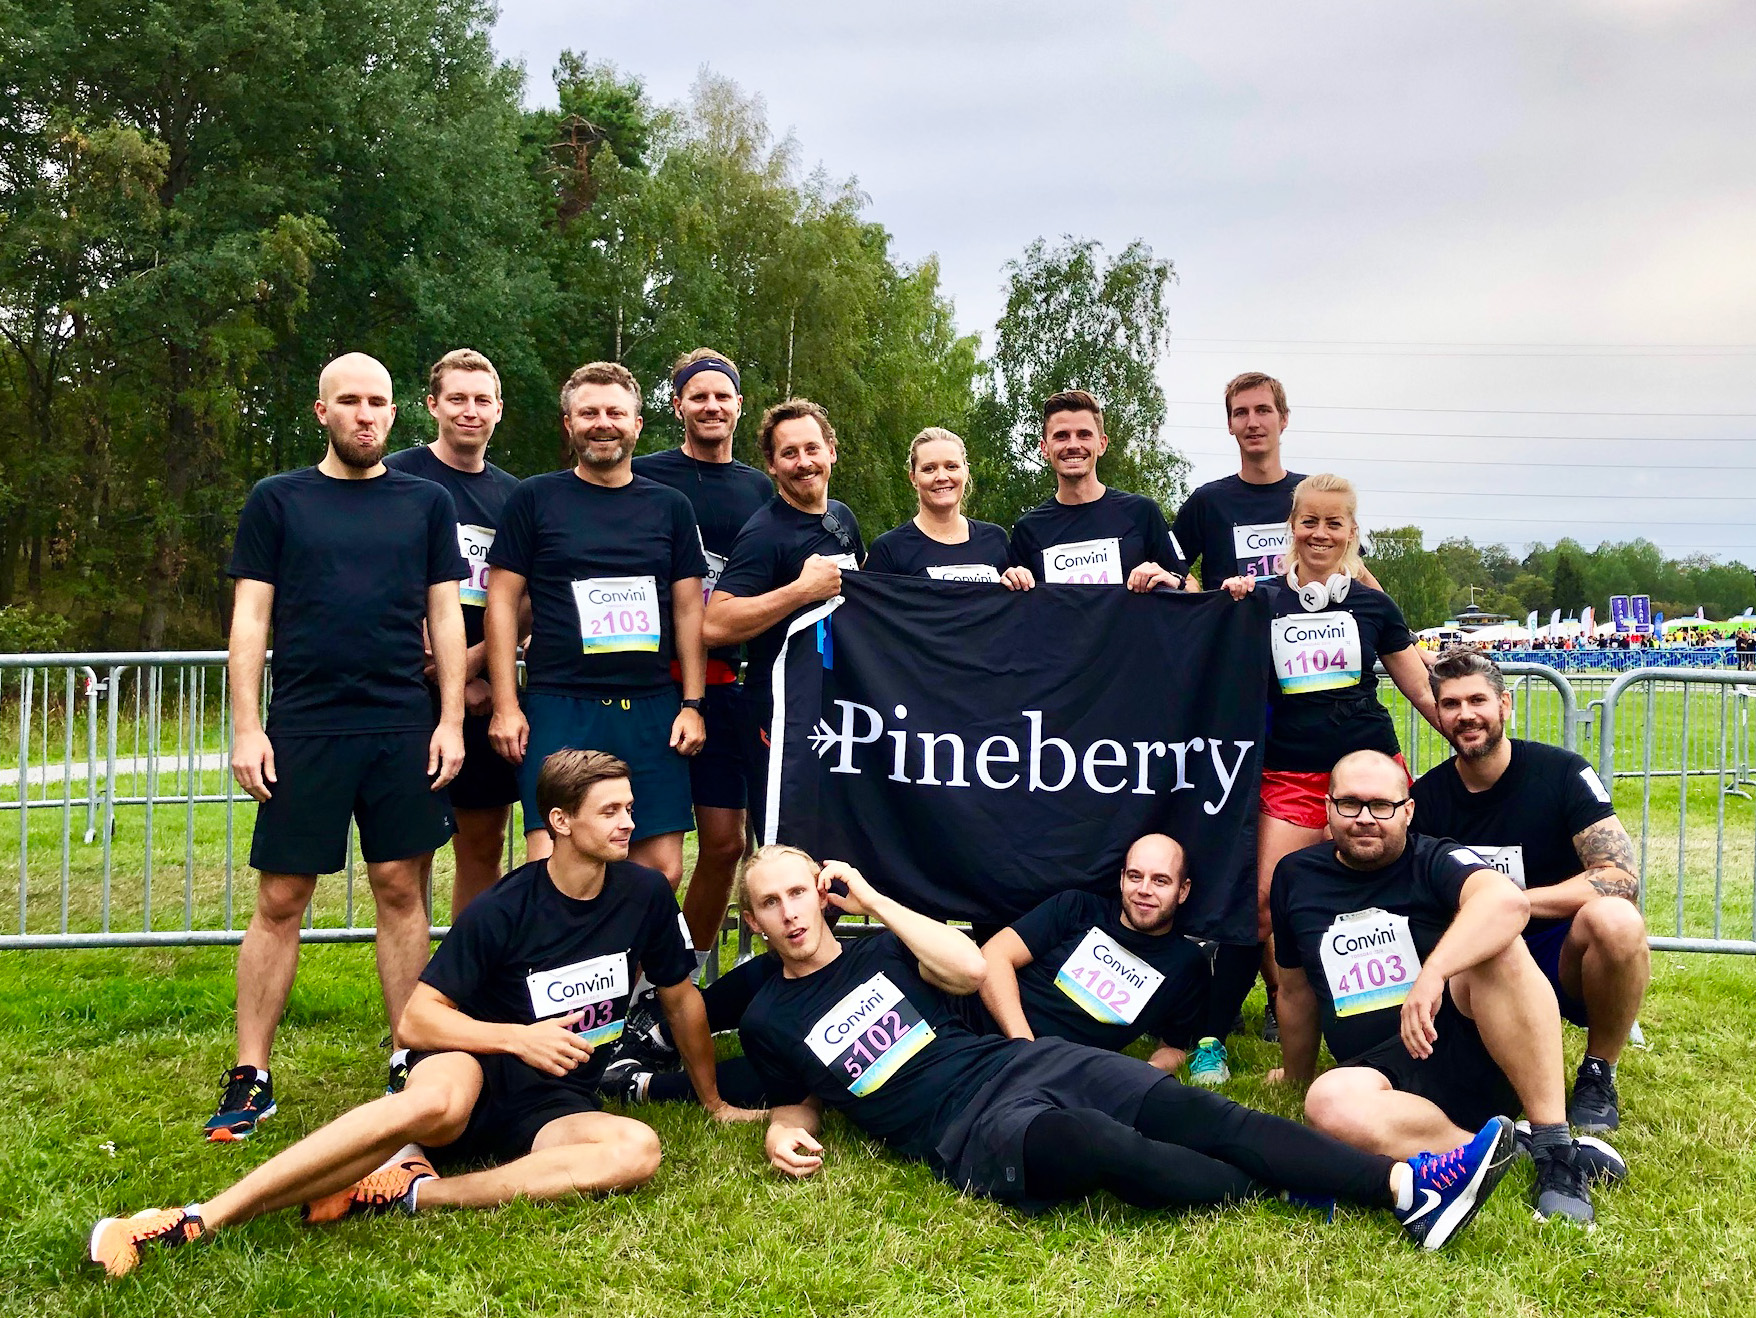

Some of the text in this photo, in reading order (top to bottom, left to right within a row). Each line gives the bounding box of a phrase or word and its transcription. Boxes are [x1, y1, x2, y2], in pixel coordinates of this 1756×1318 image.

[1054, 548, 1108, 570] Convini
[588, 587, 646, 604] Convini
[590, 610, 650, 635] 2103
[1284, 621, 1345, 643] Convini
[1284, 647, 1348, 675] 1104
[828, 699, 1255, 815] Pineberry
[1332, 922, 1396, 955] Convini
[1093, 944, 1145, 989] Convini
[1338, 954, 1407, 993] 4103
[547, 967, 614, 1002] Convini
[1071, 967, 1131, 1014] 4102
[824, 988, 884, 1044] Convini
[843, 1010, 911, 1078] 5102
